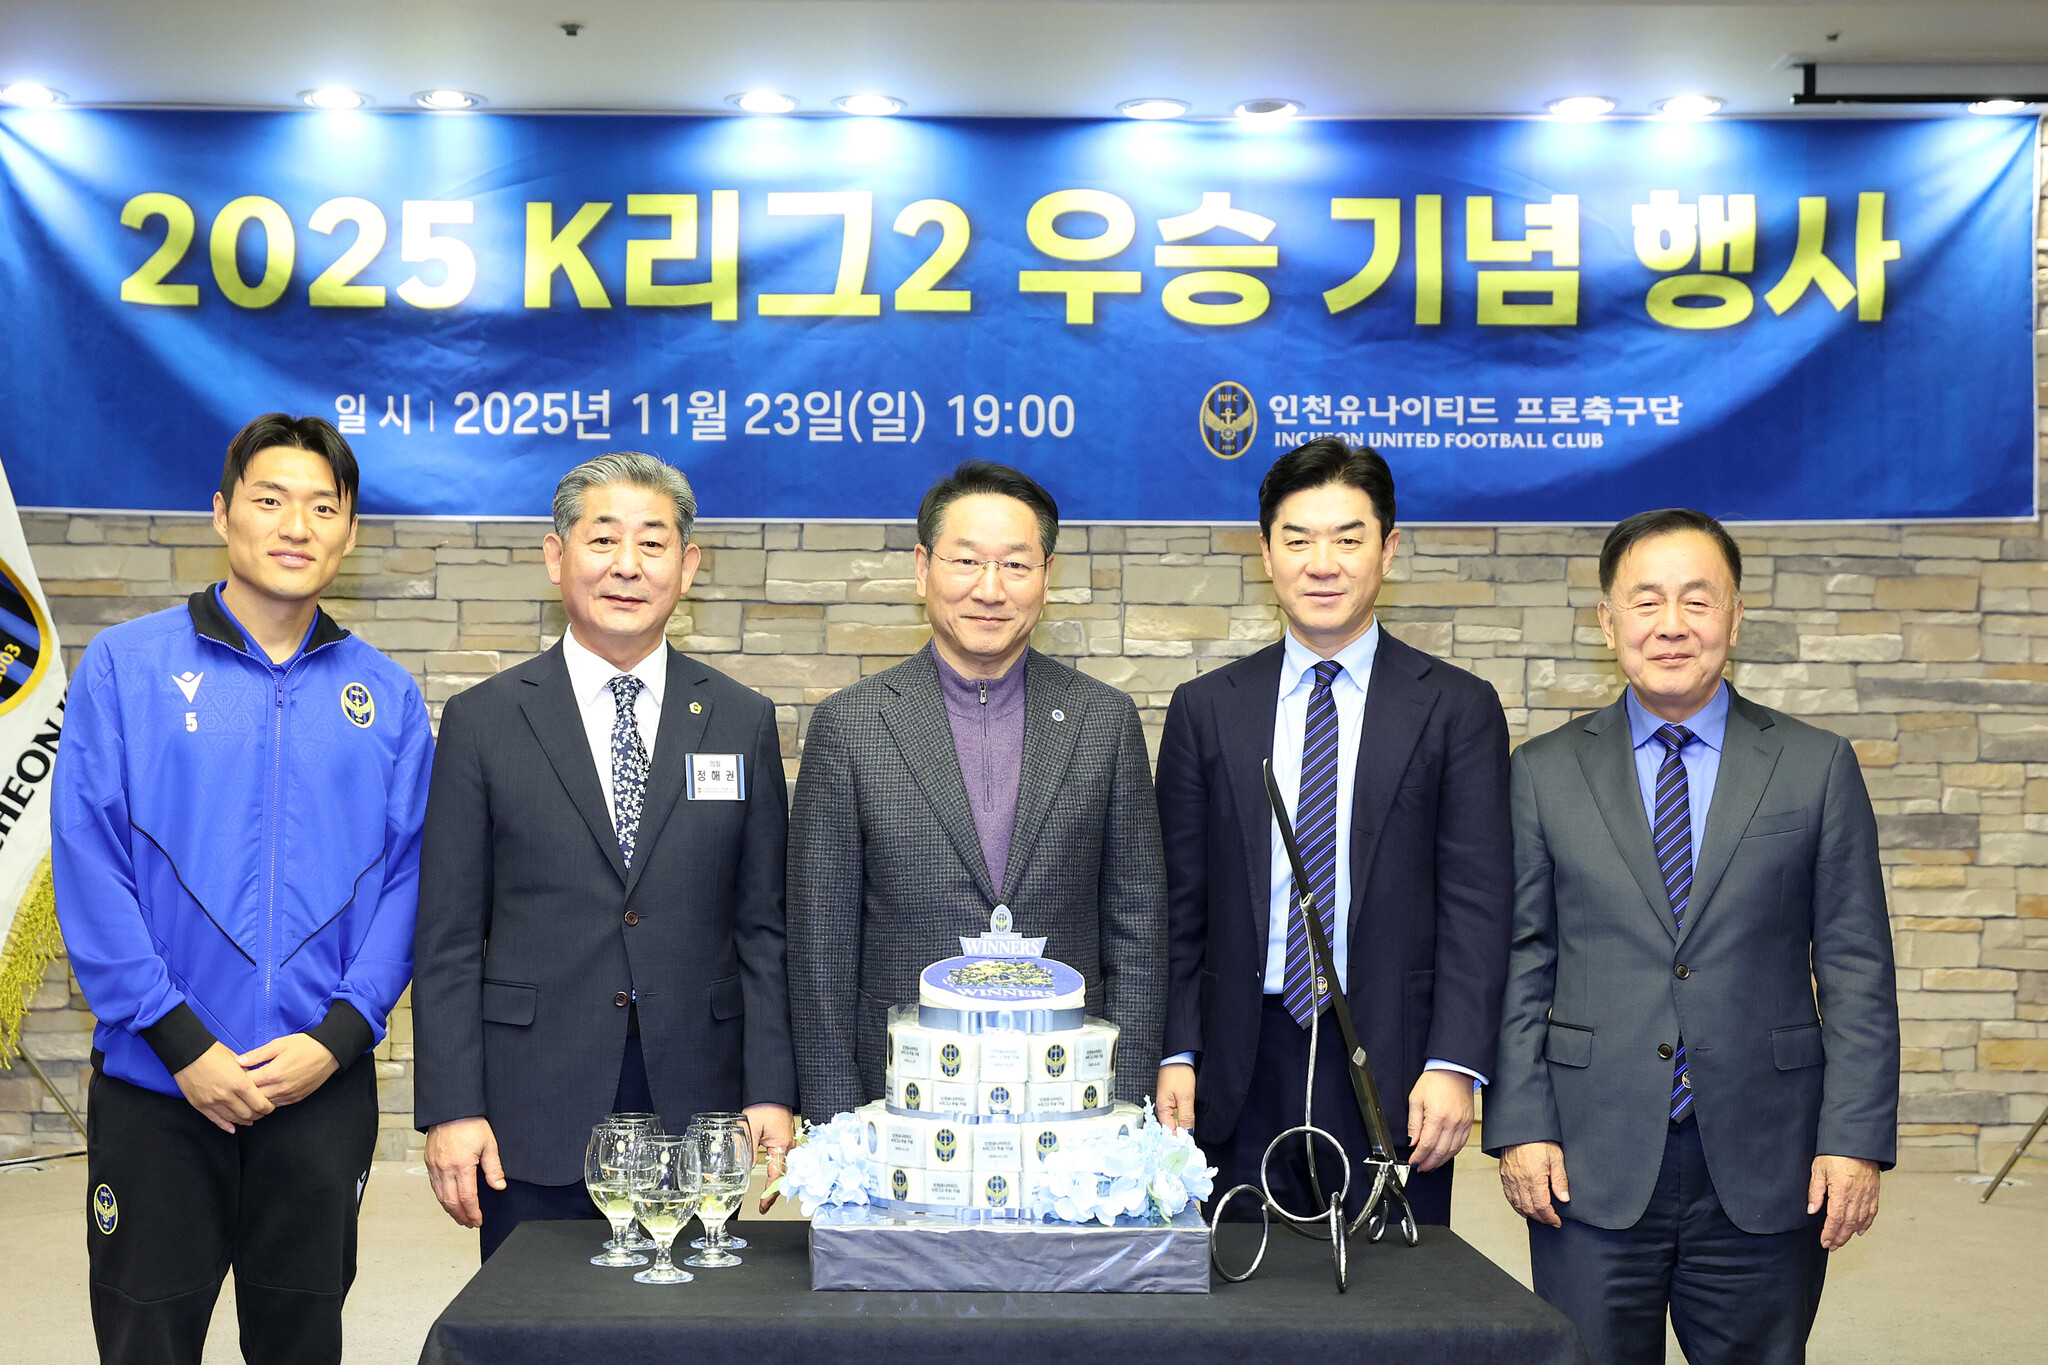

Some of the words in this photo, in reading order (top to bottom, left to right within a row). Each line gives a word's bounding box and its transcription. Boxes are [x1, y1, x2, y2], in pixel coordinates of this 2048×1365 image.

[119, 191, 477, 309] 2025
[524, 189, 971, 321] K리그2
[1019, 188, 1279, 326] 우승
[1322, 193, 1580, 326] 기념
[1631, 189, 1901, 330] 행사
[453, 389, 611, 440] 2025년
[632, 389, 727, 441] 11월
[744, 389, 926, 443] 23일(일)
[947, 394, 1075, 438] 19:00
[1268, 394, 1499, 426] 인천유나이티드
[1514, 394, 1684, 427] 프로축구단
[1368, 432, 1441, 448] UNITED
[1444, 432, 1548, 449] FOOTBALL
[1551, 432, 1604, 449] CLUB
[0, 643, 21, 684] 003
[185, 712, 198, 732] 5
[0, 718, 62, 850] HEON
[964, 940, 1040, 956] WINNERS
[955, 987, 1058, 998] WINNERS
